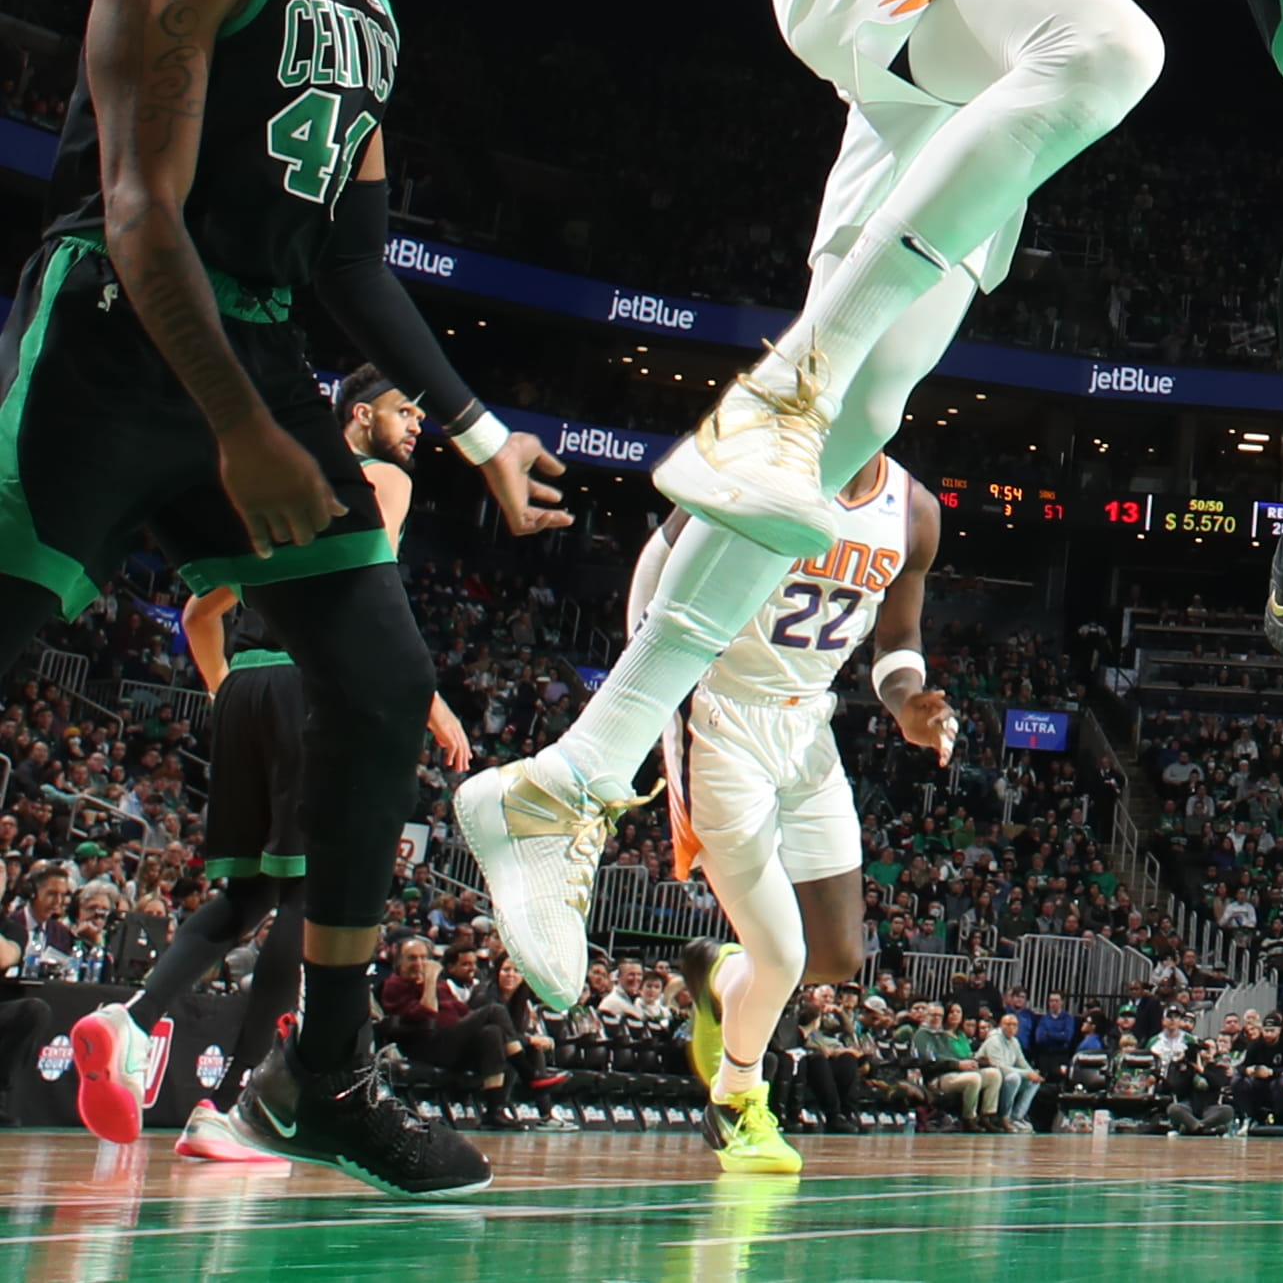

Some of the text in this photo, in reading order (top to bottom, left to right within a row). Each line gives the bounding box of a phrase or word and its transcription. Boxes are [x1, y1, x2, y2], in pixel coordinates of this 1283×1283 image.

[383, 238, 454, 277] etBlue
[608, 289, 694, 329] jetBlue
[1088, 365, 1173, 400] jetBlue
[556, 423, 645, 461] jetBlue
[942, 478, 1055, 500] CELTICS 9:54 SUNS
[940, 492, 1064, 520] 46 57
[1105, 501, 1139, 523] 13
[1187, 500, 1223, 515] 50/50
[1165, 513, 1236, 533] $ 5.570
[789, 538, 900, 592] UNS
[771, 581, 863, 650] 22
[1014, 720, 1056, 734] ULTRA
[38, 1058, 71, 1070] COURT
[196, 1066, 225, 1077] COURT
[198, 1055, 224, 1066] CENTER
